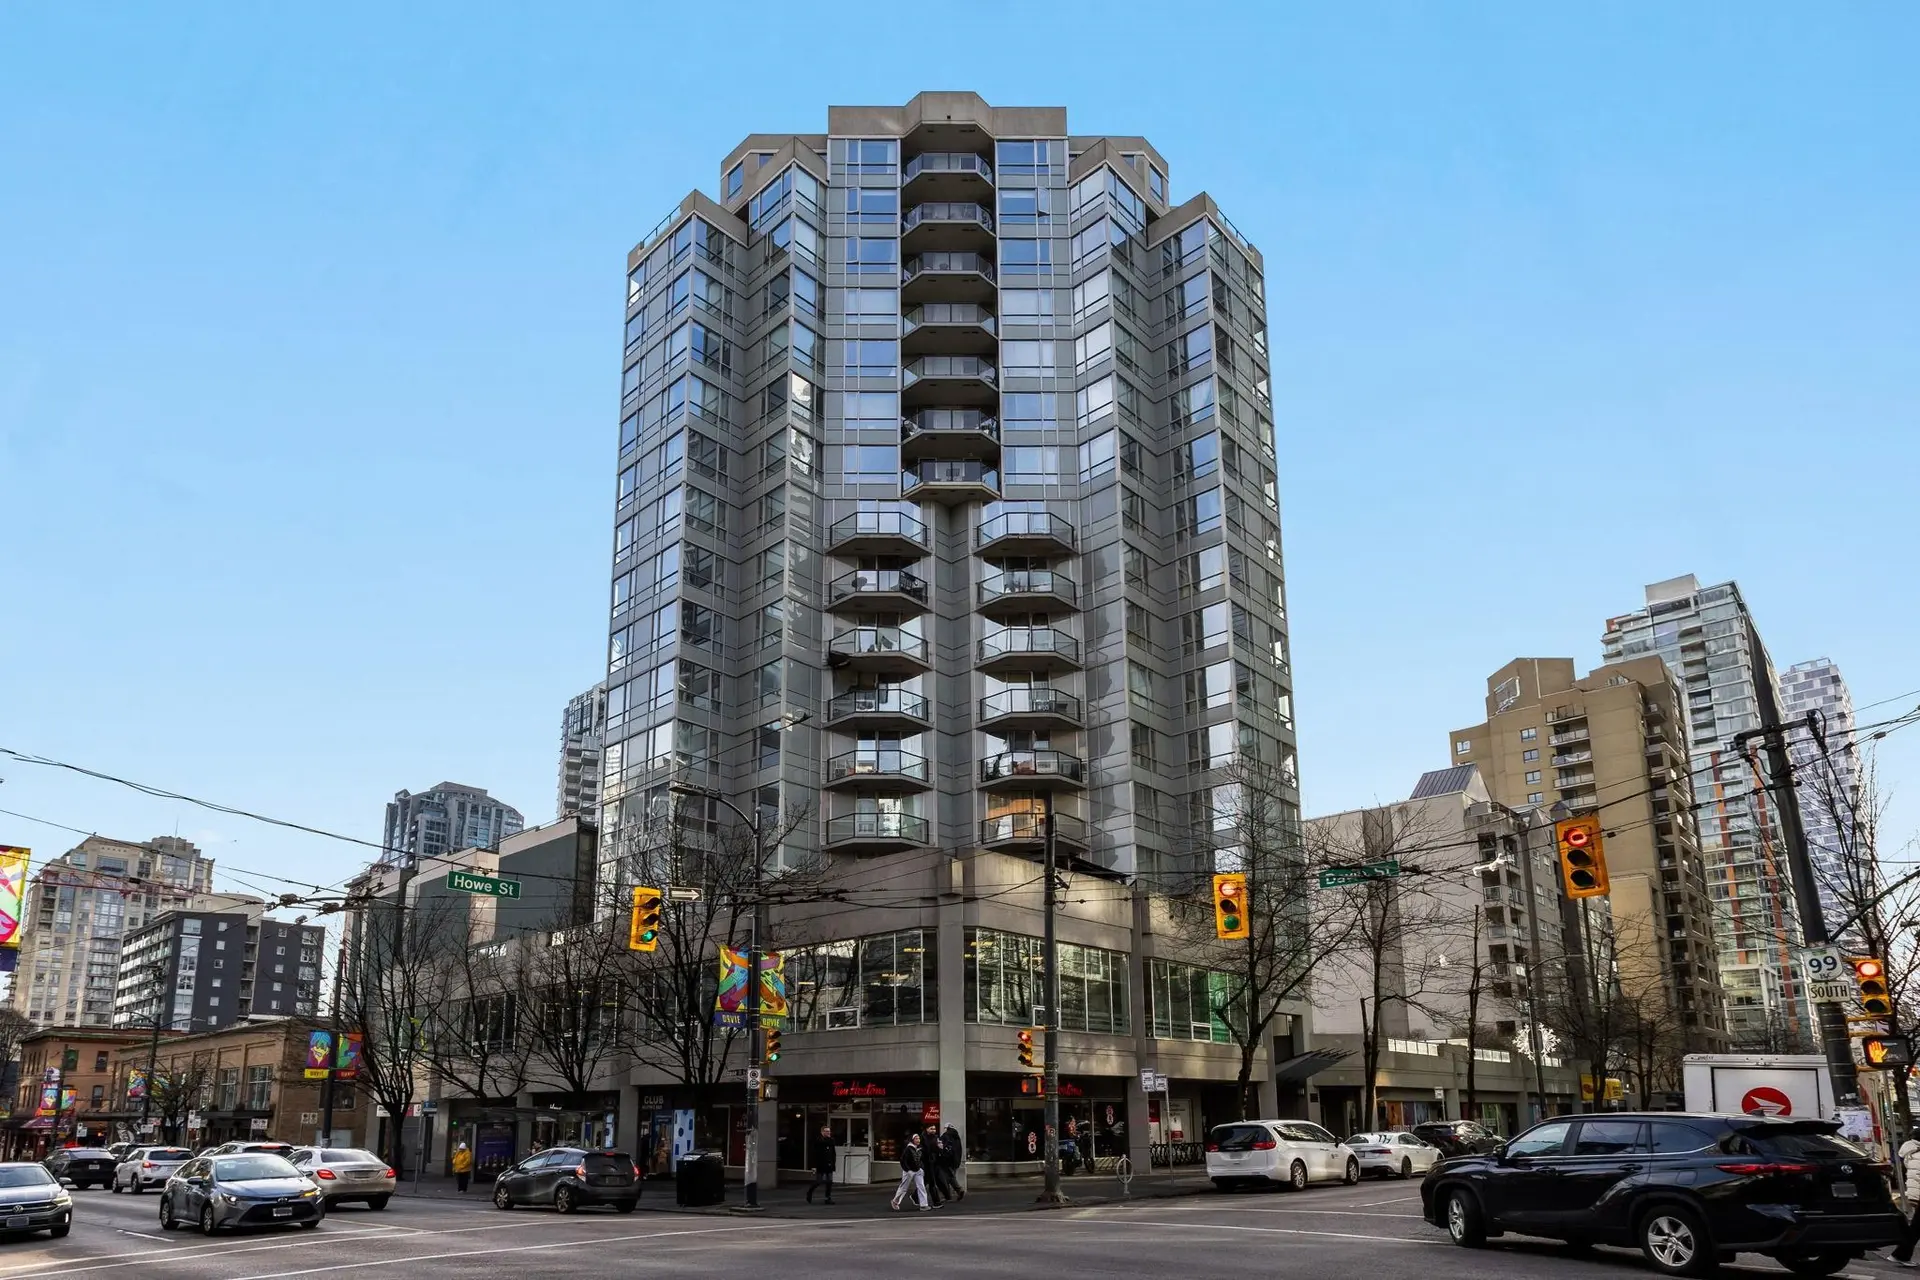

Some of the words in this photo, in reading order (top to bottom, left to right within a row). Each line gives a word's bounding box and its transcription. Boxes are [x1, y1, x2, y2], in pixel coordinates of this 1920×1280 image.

[454, 874, 492, 892] Howe
[498, 882, 514, 896] St
[1809, 955, 1837, 973] 99
[1810, 985, 1848, 999] SOUTH
[722, 1014, 740, 1024] DAVIE
[762, 1017, 780, 1027] DAVIE
[832, 1081, 849, 1096] Tim
[850, 1080, 886, 1096] Hortons
[644, 1095, 664, 1105] CLUB
